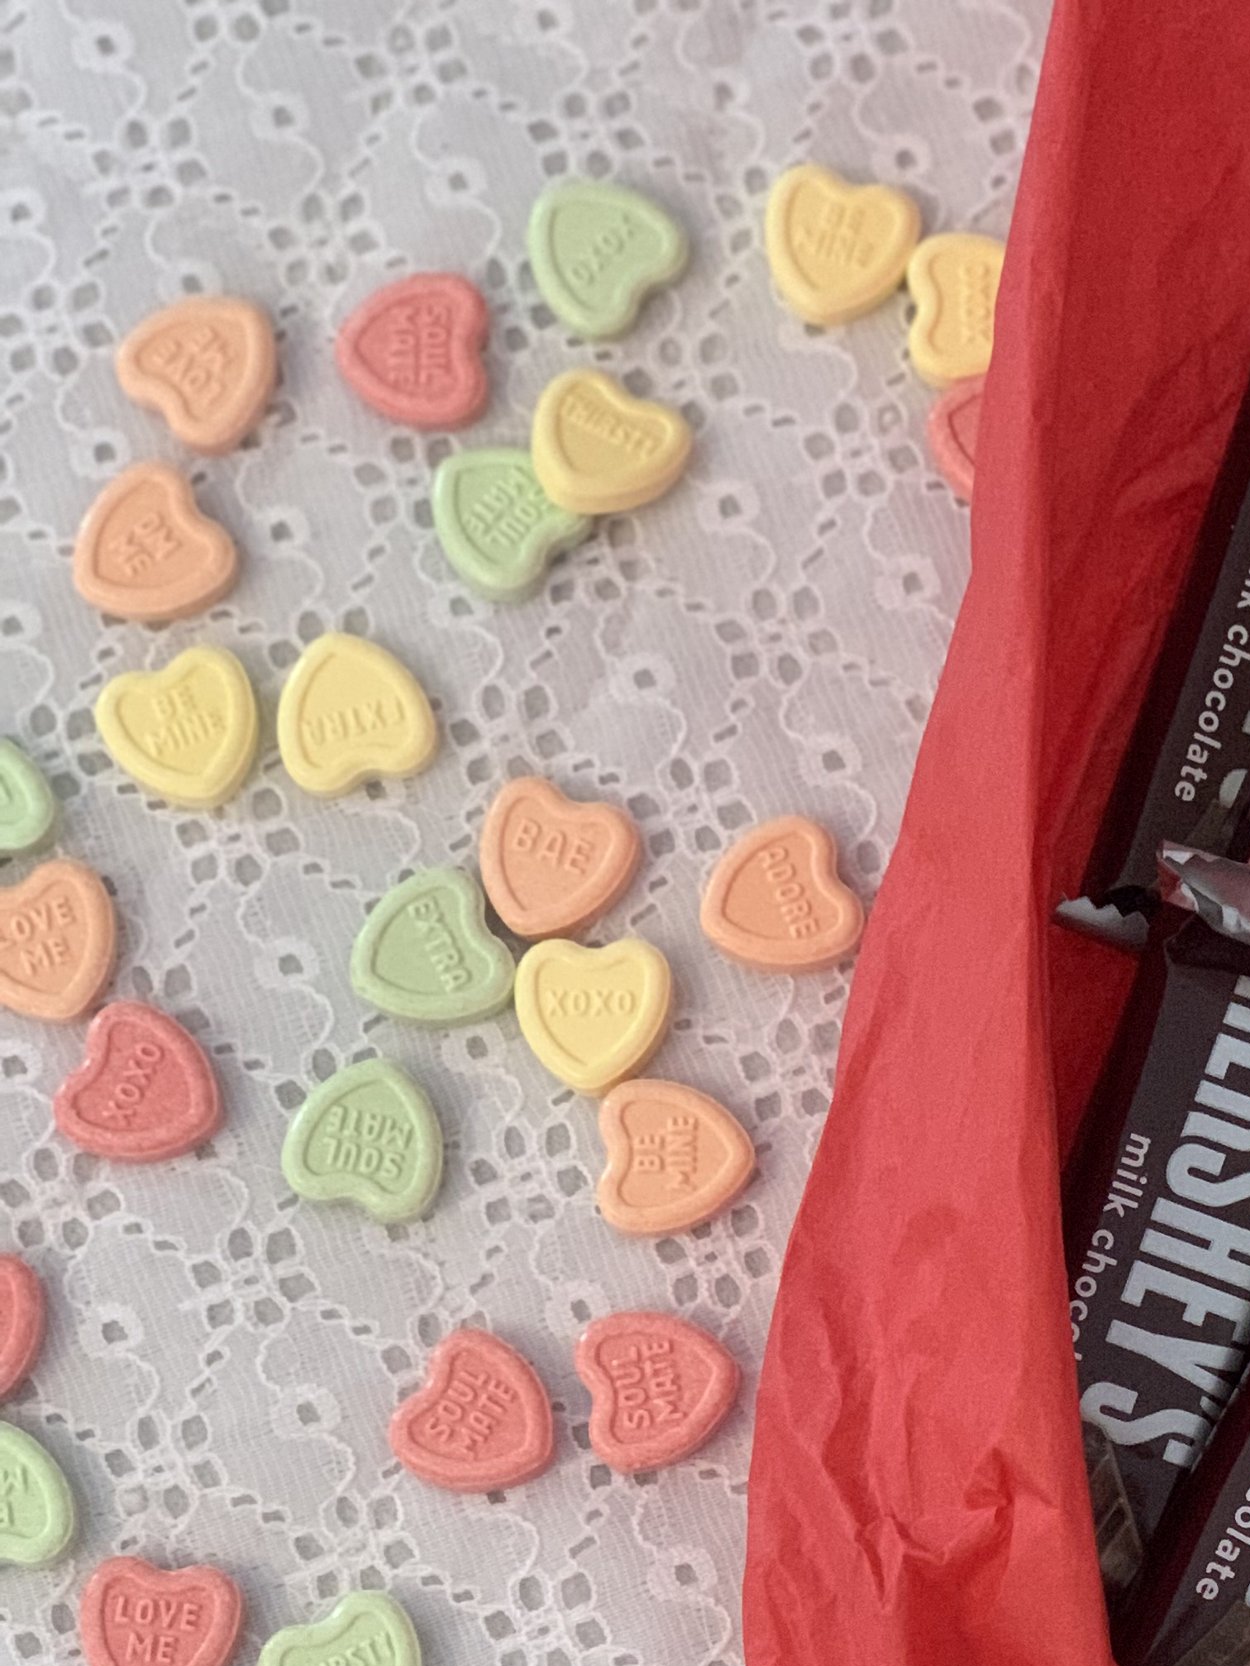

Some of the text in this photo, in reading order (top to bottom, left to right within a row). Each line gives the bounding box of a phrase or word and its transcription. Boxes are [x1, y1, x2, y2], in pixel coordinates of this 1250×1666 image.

[190, 322, 239, 374] ME
[388, 306, 416, 386] MATE
[423, 304, 451, 385] SOUL
[457, 461, 531, 539] MATE
[107, 529, 154, 580] ME
[134, 510, 182, 563] DM
[143, 705, 227, 760] MINE
[149, 683, 197, 722] BE
[1174, 621, 1250, 803] chocolate
[511, 813, 596, 876] BAE
[756, 843, 820, 941] ADORE
[20, 935, 71, 977] ME
[404, 893, 471, 994] EXTRA
[544, 990, 634, 1016] XOXO
[101, 1038, 168, 1129] XOXO
[320, 1133, 406, 1187] SOUL
[323, 1101, 414, 1155] MATE
[634, 1135, 660, 1173] BE
[665, 1116, 698, 1191] MINE
[1102, 1132, 1151, 1217] milk
[423, 1361, 490, 1444] SOUL
[615, 1344, 647, 1428] SOUL
[647, 1339, 682, 1420] MATE
[449, 1377, 518, 1456] MATE
[114, 1594, 199, 1631] LOVE
[126, 1631, 176, 1664] ME
